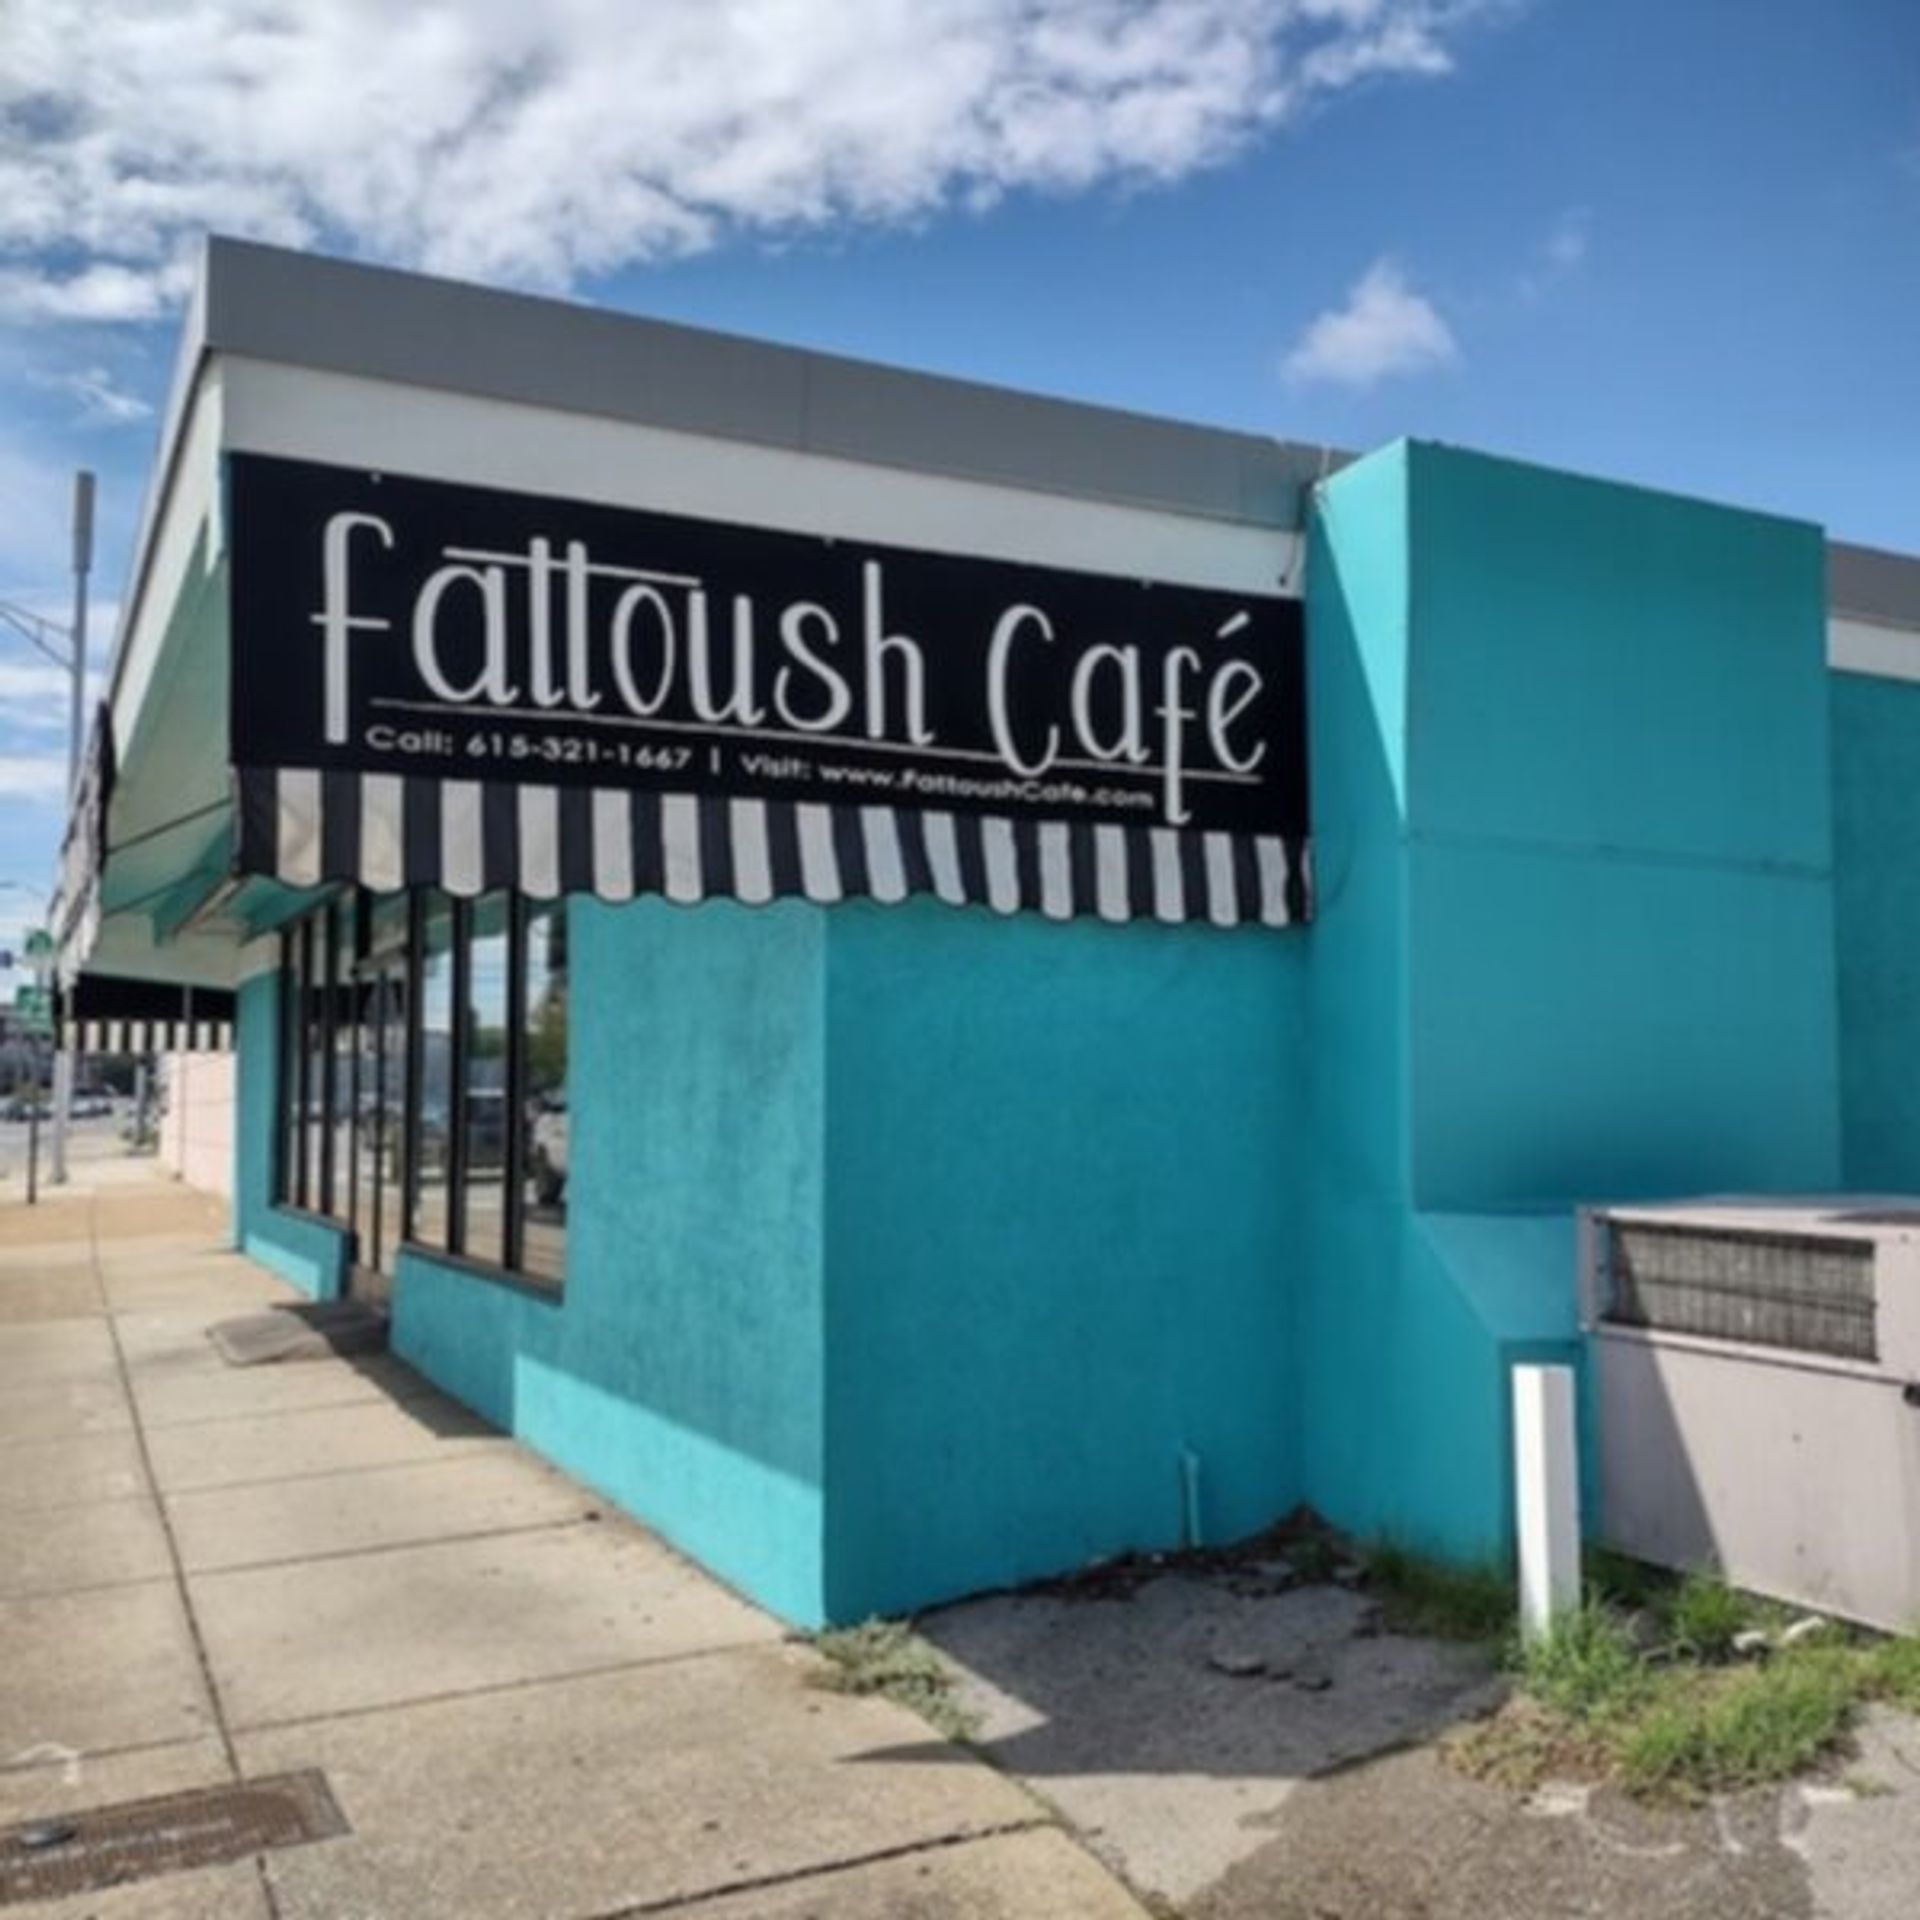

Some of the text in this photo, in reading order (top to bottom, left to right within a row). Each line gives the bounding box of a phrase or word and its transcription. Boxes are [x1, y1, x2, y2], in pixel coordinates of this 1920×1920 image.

[365, 725, 453, 754] Call:
[467, 734, 692, 770] 615-321-1667
[740, 753, 812, 780] Visit:
[987, 604, 1265, 824] Café
